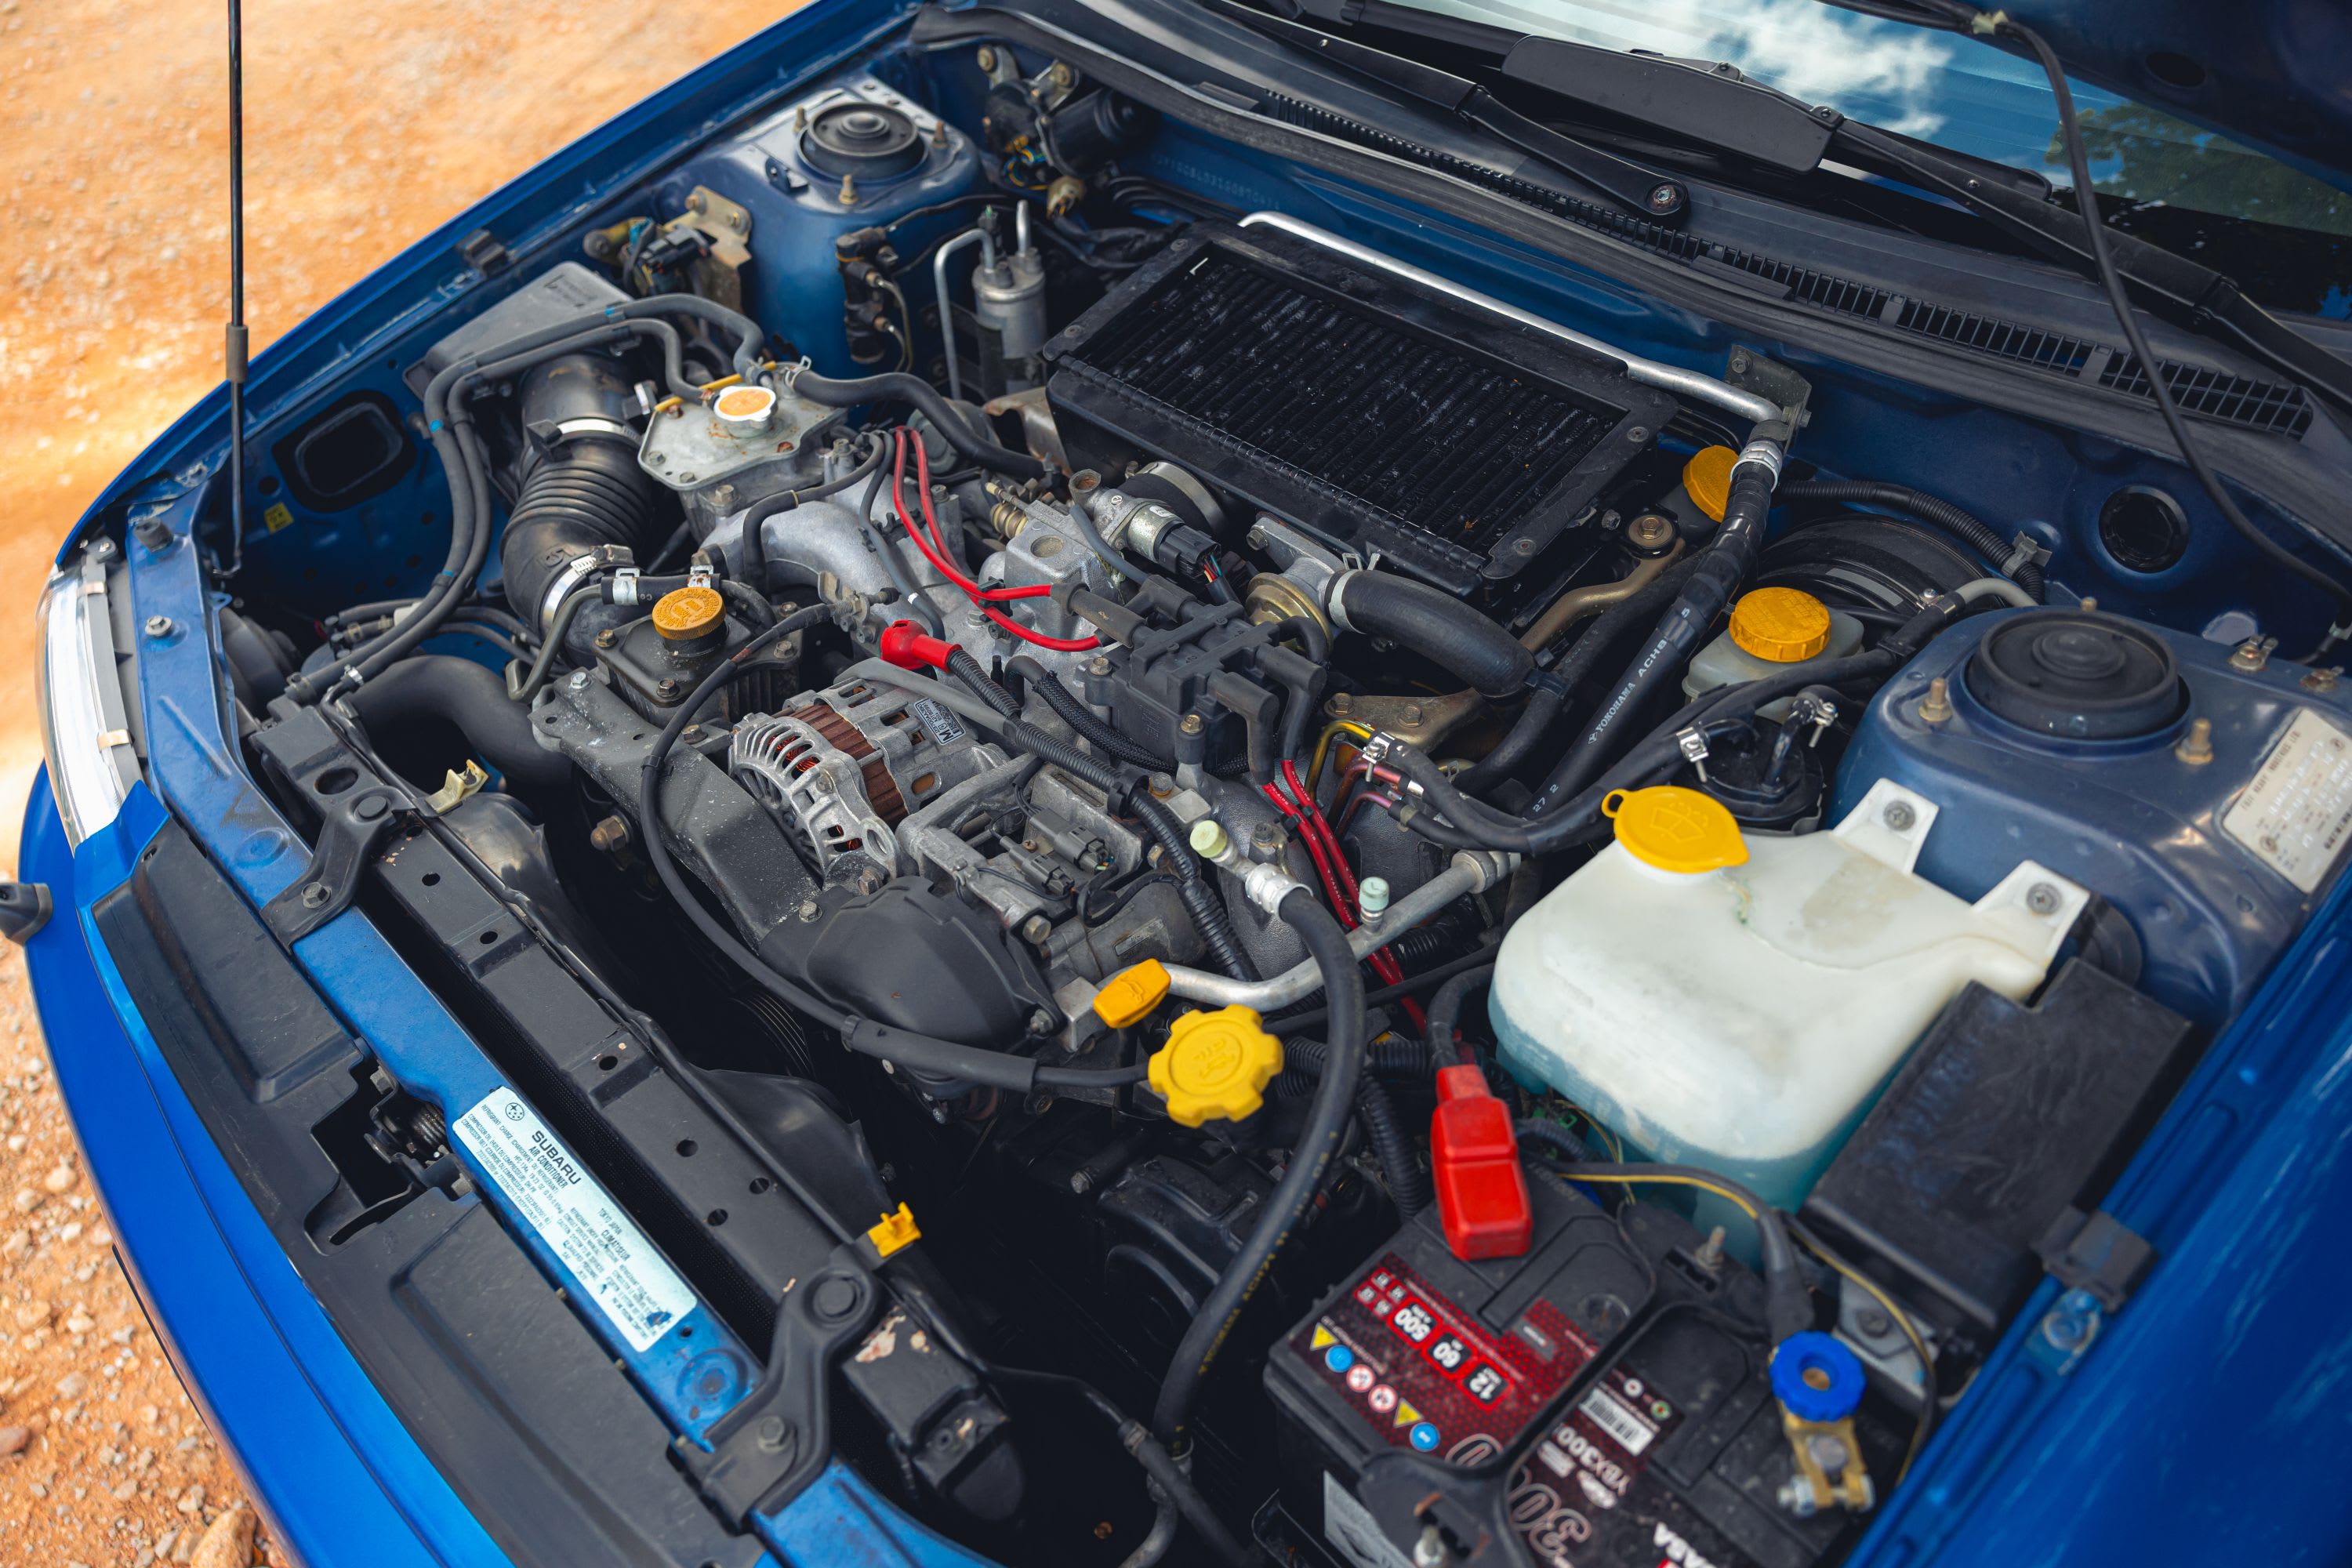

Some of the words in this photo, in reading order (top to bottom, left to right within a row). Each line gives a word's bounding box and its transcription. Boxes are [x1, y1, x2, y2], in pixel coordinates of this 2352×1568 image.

[1533, 797, 1547, 812] 27
[1549, 783, 1559, 793] 2
[1594, 681, 1636, 732] YOKOHAMA
[528, 1145, 539, 1156] AIR
[537, 1155, 568, 1188] CONDITIONER
[531, 1131, 581, 1184] SUBARU
[1392, 1306, 1432, 1342] 500
[1431, 1340, 1461, 1369] 60
[1468, 1371, 1497, 1399] 12
[1553, 1421, 1632, 1496] YBX300
